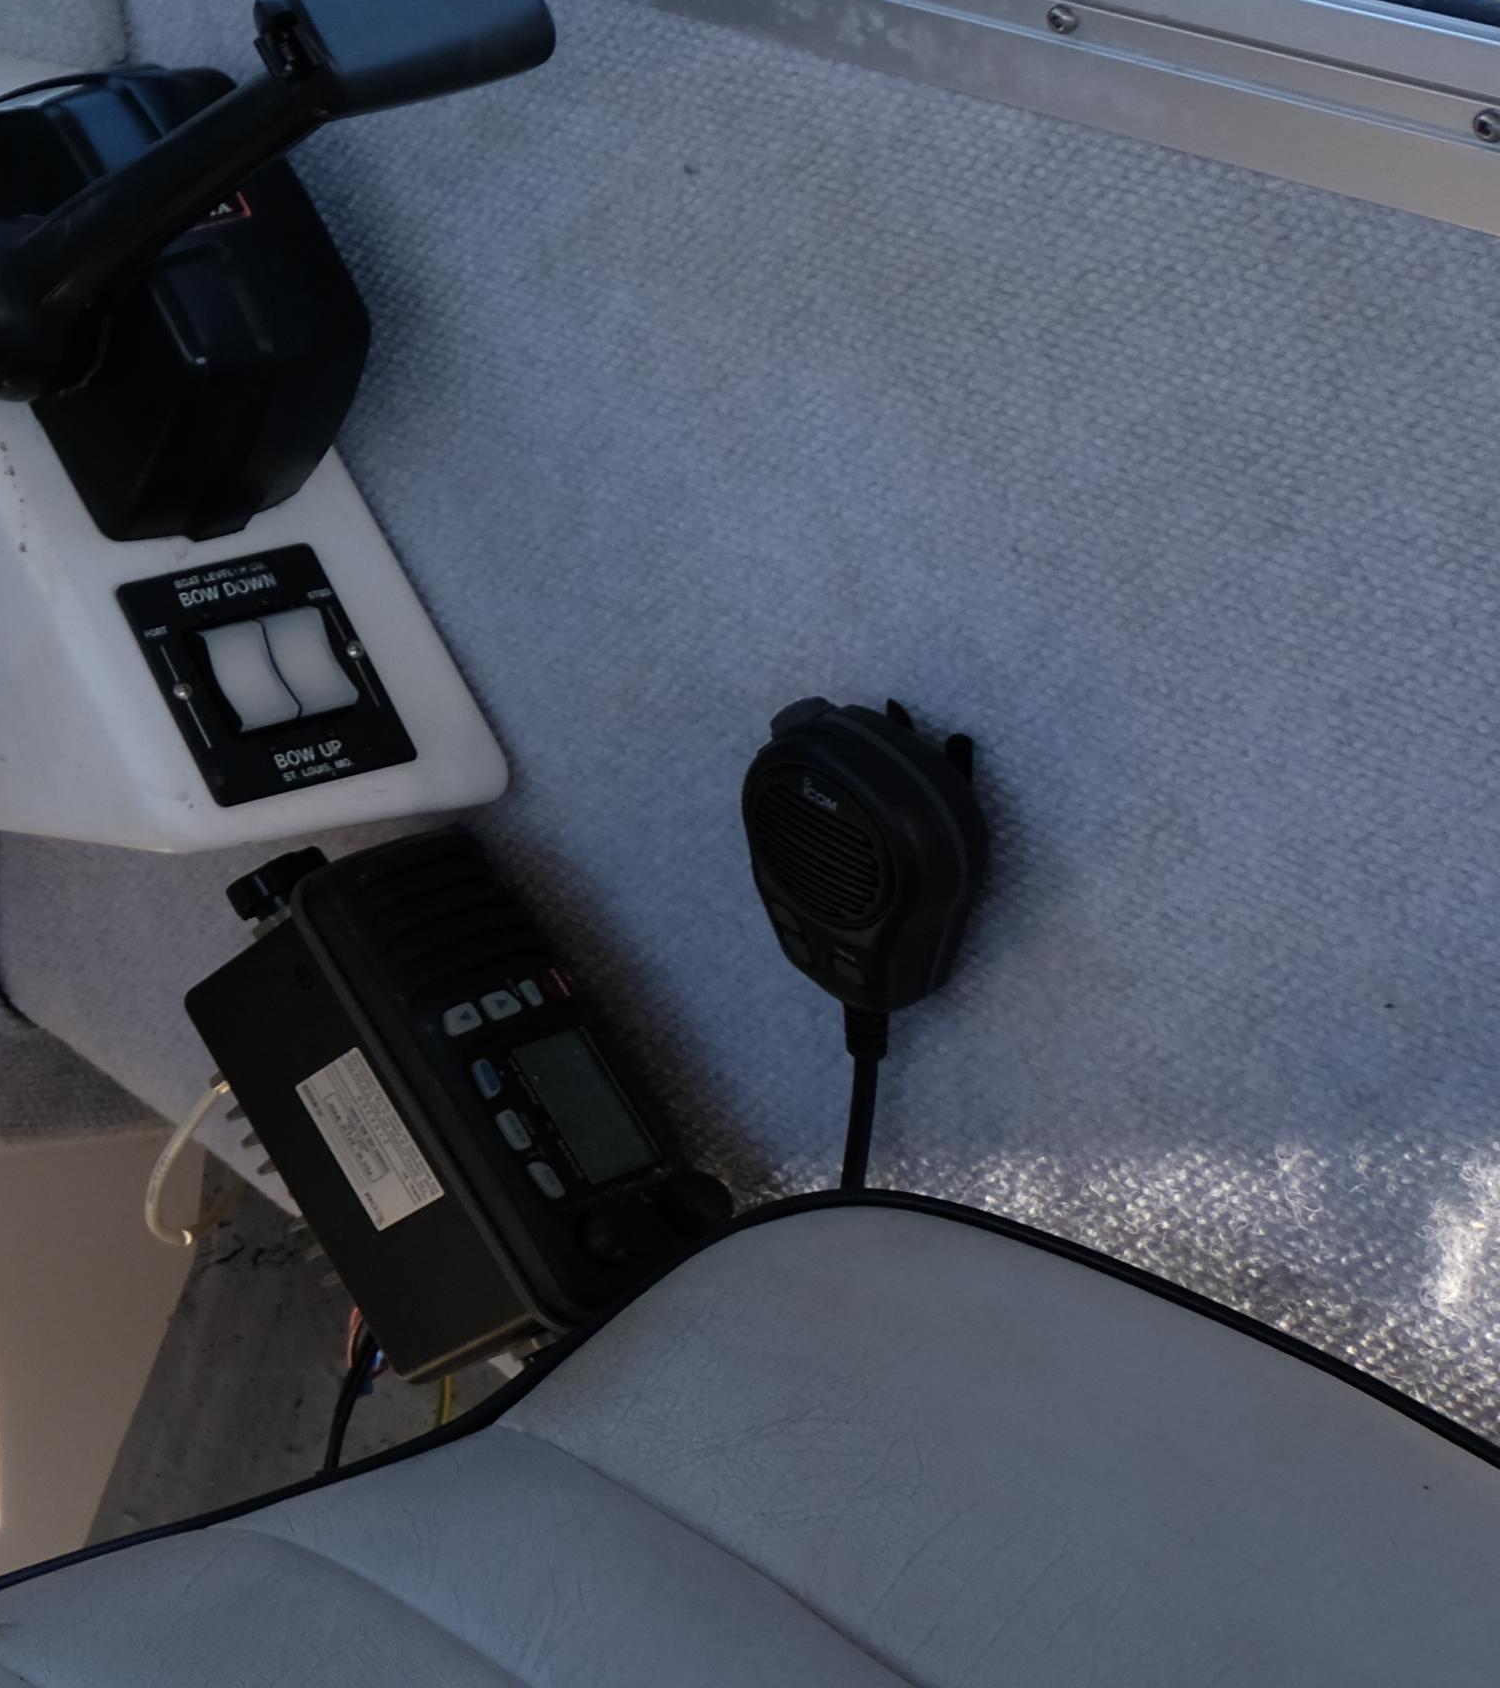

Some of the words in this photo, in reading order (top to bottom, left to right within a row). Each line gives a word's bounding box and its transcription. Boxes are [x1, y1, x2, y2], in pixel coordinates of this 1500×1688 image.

[178, 585, 220, 608] BOW
[223, 573, 277, 597] DOWN
[274, 746, 315, 768] BOW
[318, 739, 342, 757] UP
